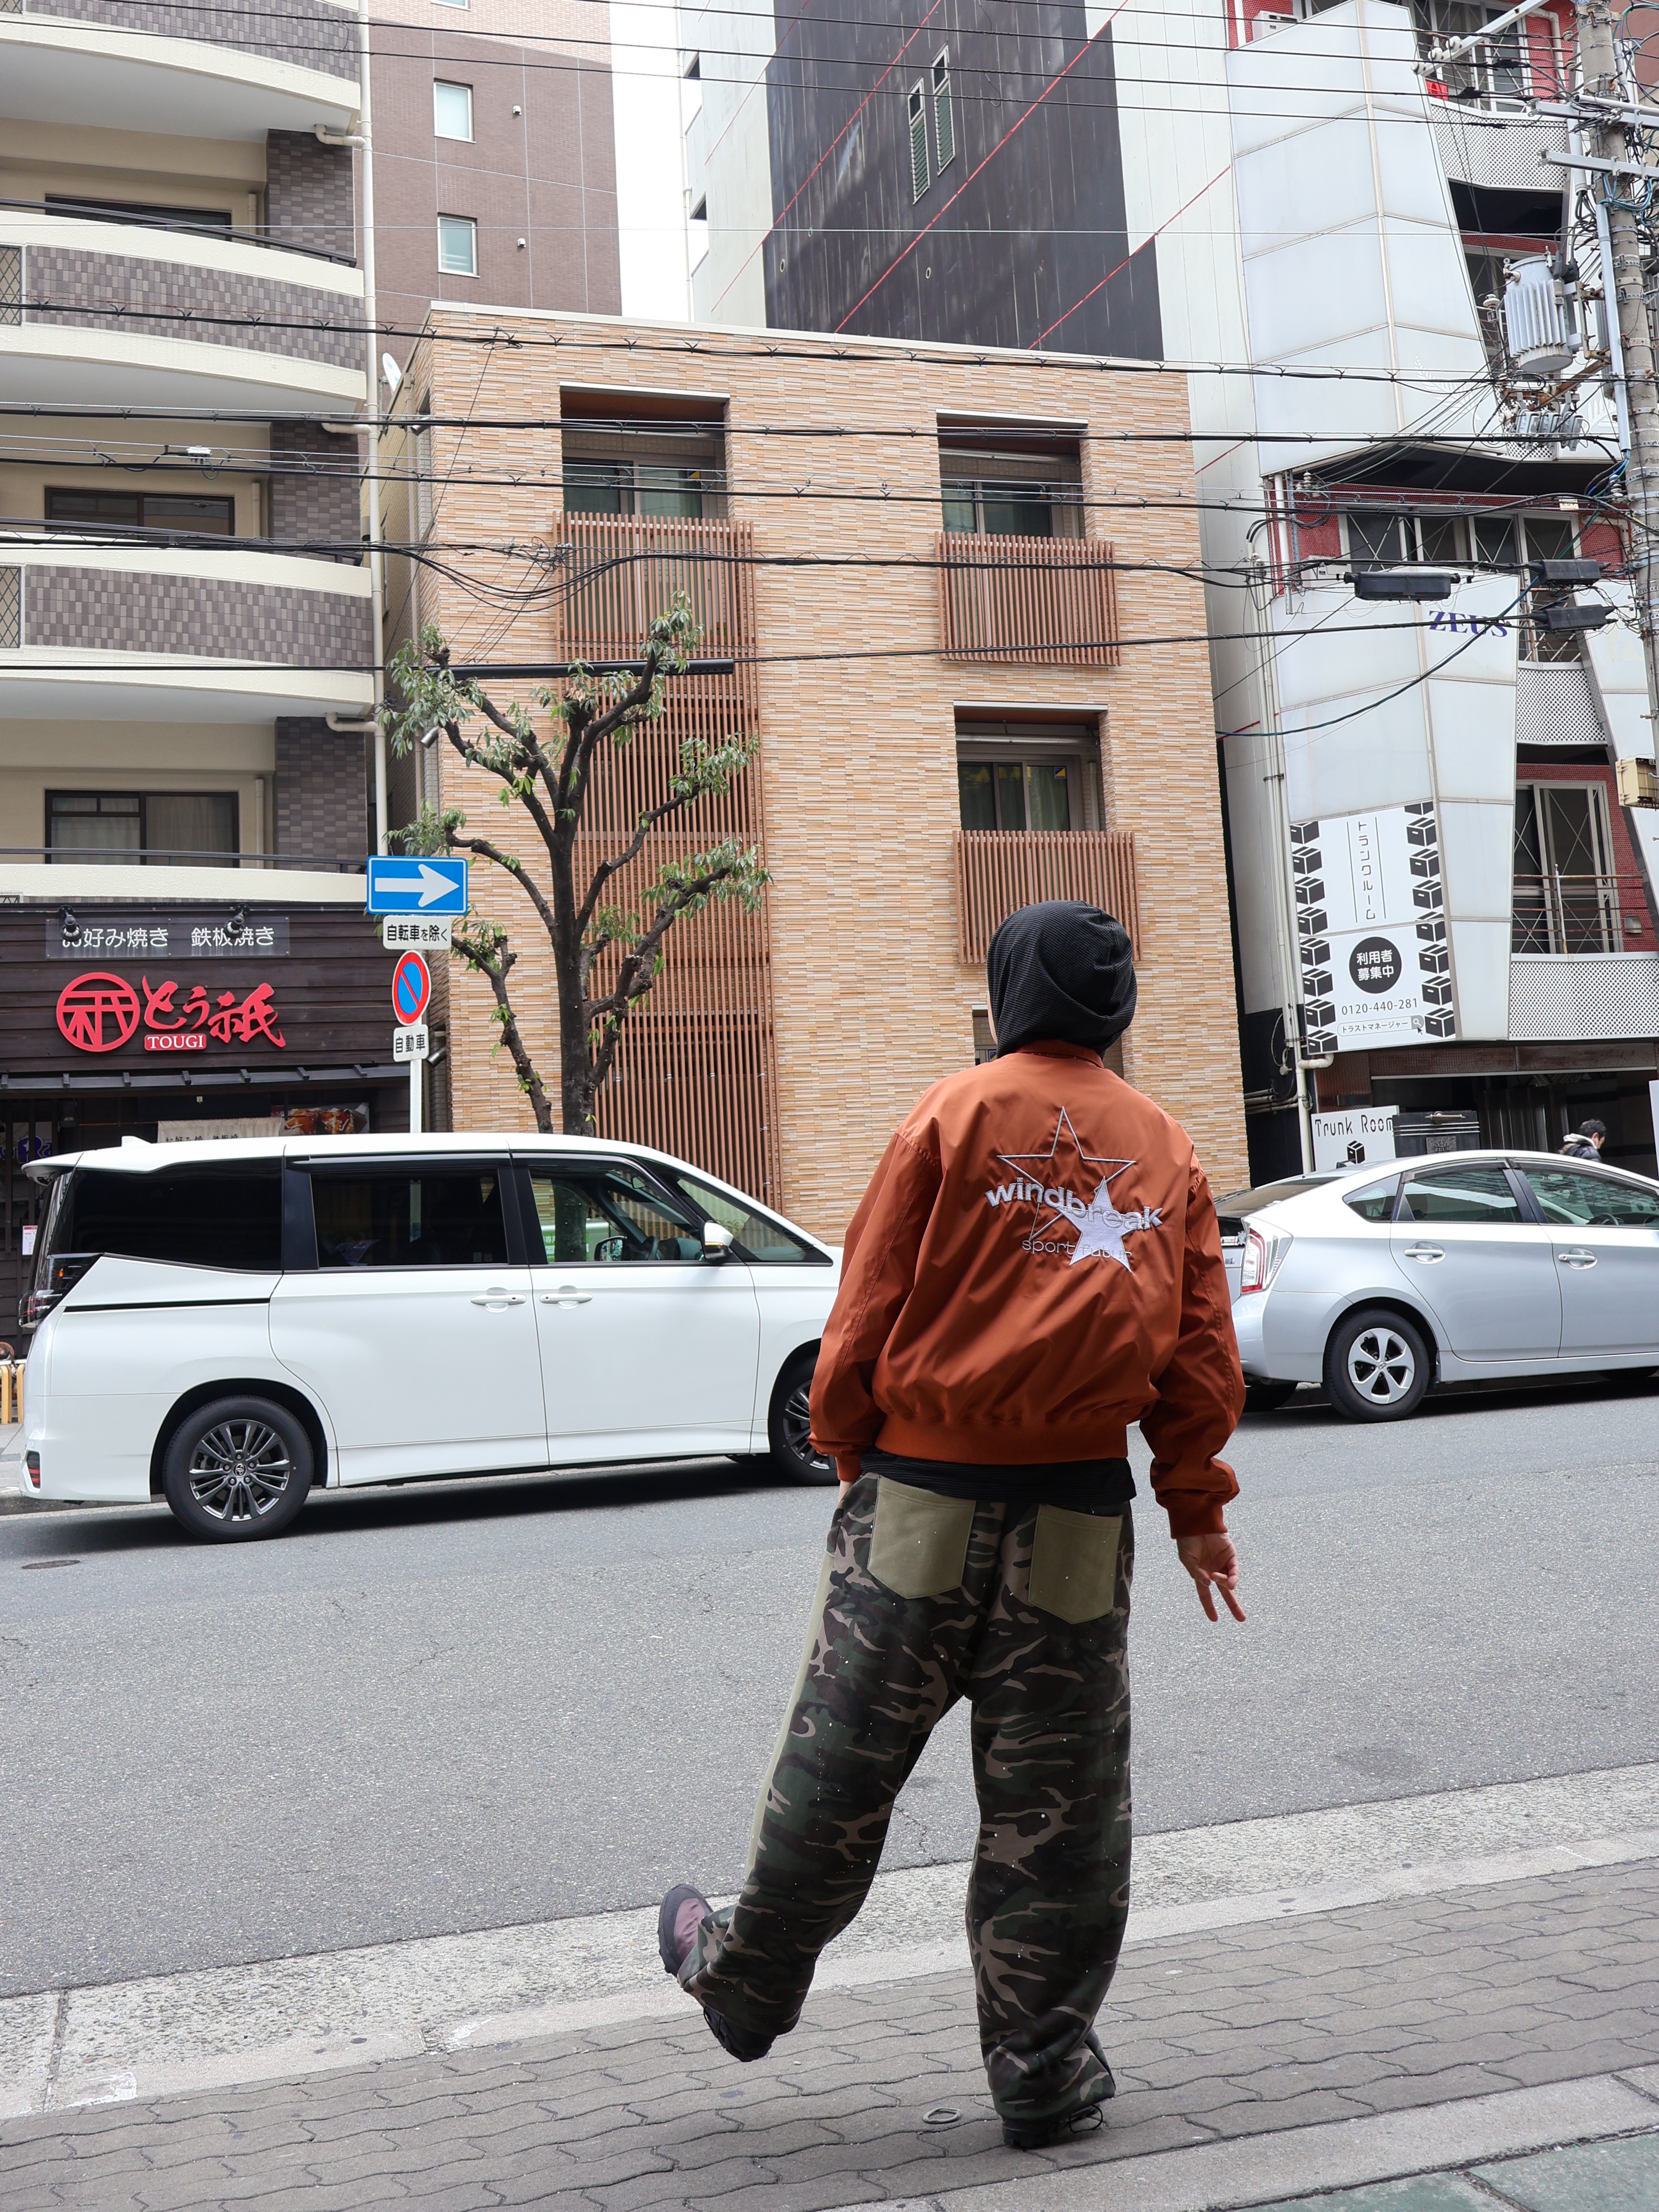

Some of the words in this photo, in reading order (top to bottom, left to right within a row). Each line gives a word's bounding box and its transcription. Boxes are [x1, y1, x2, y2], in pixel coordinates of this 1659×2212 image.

[1428, 610, 1508, 638] ZEUS
[1359, 821, 1375, 920] トランクルーム
[387, 924, 448, 942] 自転車を除く
[1356, 950, 1393, 965] 利用者
[1358, 965, 1394, 981] 募集中
[1341, 998, 1418, 1015] 0120-440-281
[1342, 1021, 1408, 1033] トラストマネージャー
[147, 1035, 204, 1049] TOUGI
[395, 1033, 426, 1053] 自動車
[1315, 1117, 1353, 1137] Trunk
[985, 1177, 1162, 1230] windbreak
[1022, 1240, 1075, 1254] sport
